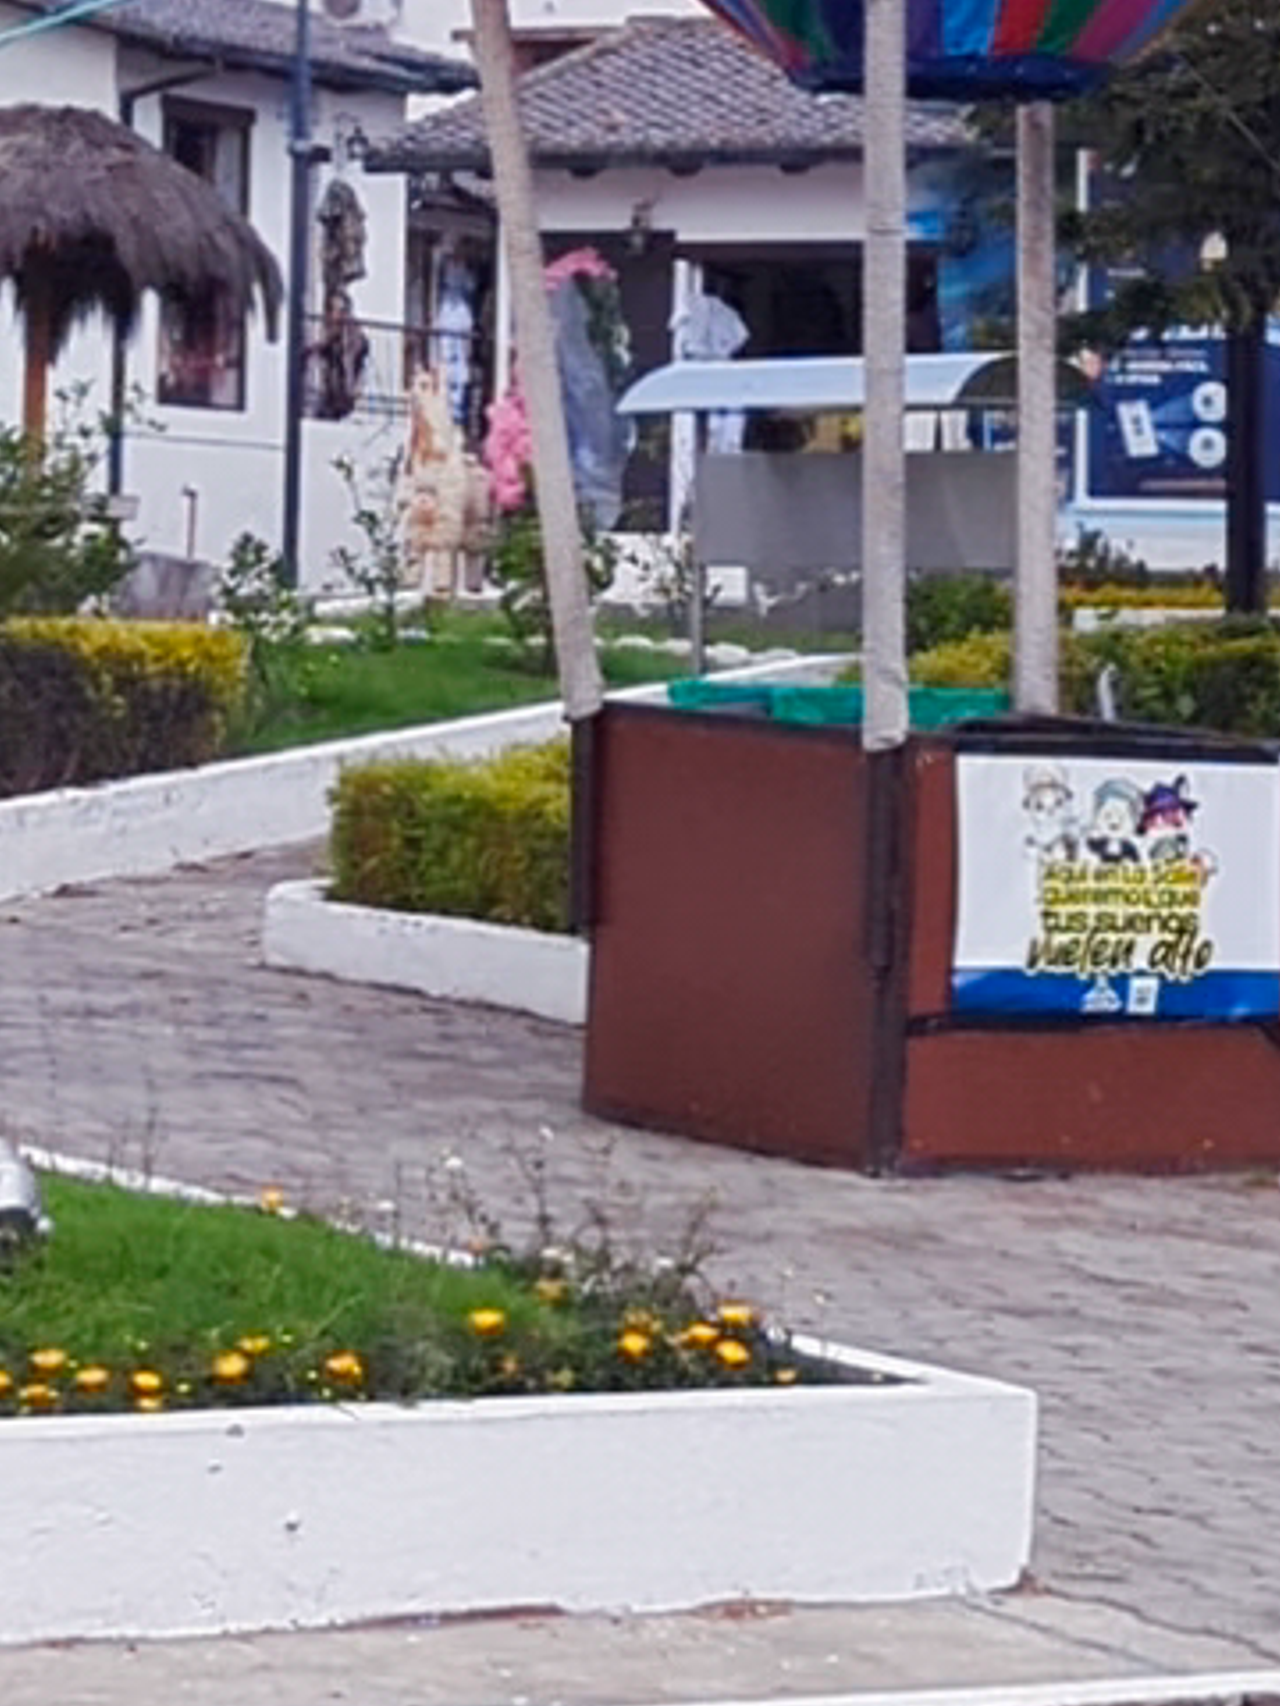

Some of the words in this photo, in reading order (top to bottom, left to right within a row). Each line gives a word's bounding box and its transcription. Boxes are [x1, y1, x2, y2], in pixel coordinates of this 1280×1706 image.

[1043, 861, 1088, 884] Aquí
[1093, 866, 1119, 882] en
[1122, 863, 1147, 883] La
[1042, 886, 1154, 906] queremos
[1158, 887, 1200, 908] que
[1041, 909, 1089, 933] tus
[1027, 928, 1136, 972] vuelen
[1148, 931, 1213, 974] alto
